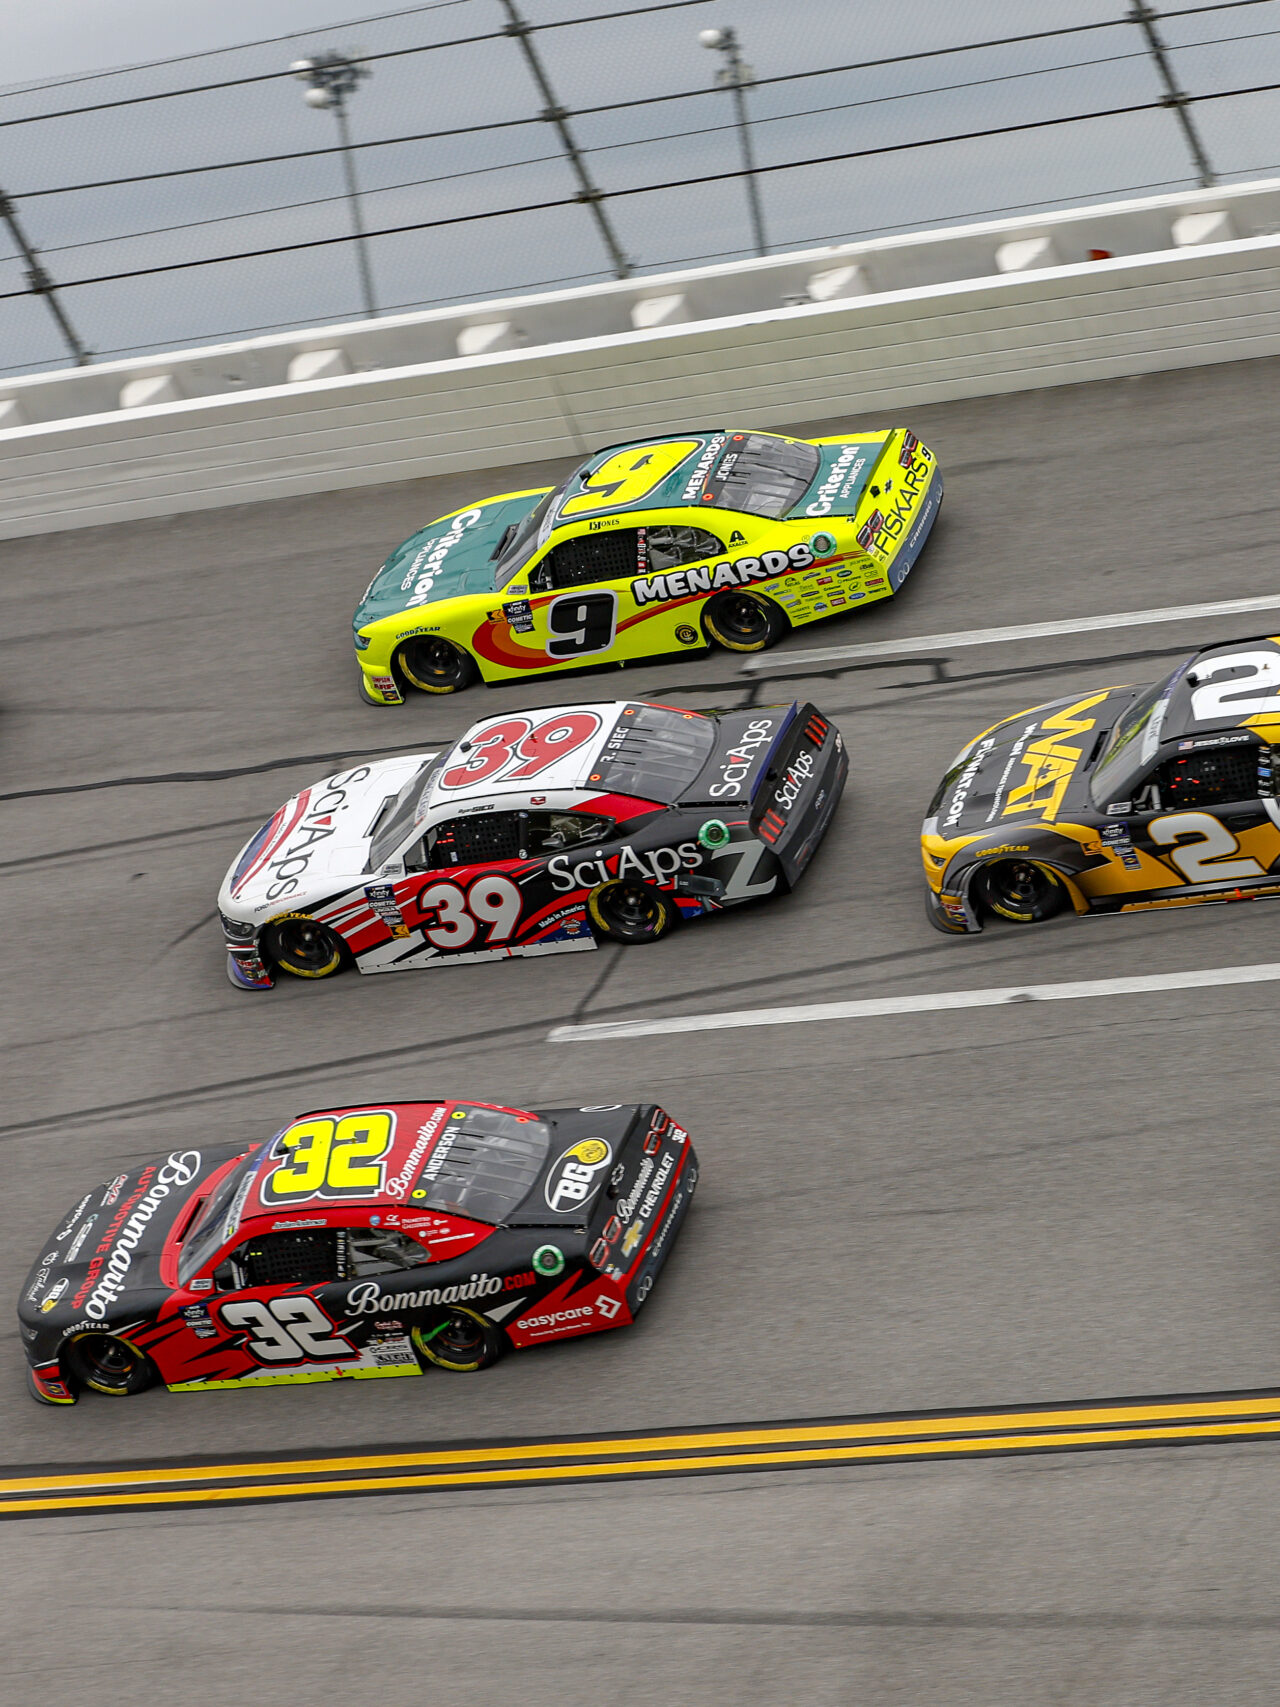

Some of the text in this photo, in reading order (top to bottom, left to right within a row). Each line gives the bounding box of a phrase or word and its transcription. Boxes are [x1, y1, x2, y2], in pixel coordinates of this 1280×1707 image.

[557, 438, 706, 520] 9
[682, 434, 727, 501] MENARDS
[715, 453, 738, 481] JONES
[806, 445, 860, 516] Criterion
[840, 458, 866, 498] APPLIANCES
[873, 457, 929, 556] FISKARS
[405, 508, 482, 607] Criterion
[632, 542, 814, 605] MENARDS
[396, 626, 441, 640] GOODYEAR
[546, 589, 619, 660] 9
[438, 710, 603, 791] 39
[607, 726, 630, 751] SIEG
[709, 719, 773, 797] SciAps
[1000, 690, 1111, 822] WAT
[774, 750, 814, 811] SciAps
[266, 766, 372, 901] SciAps
[1146, 811, 1269, 885] 2
[547, 843, 703, 892] SciAps
[417, 872, 523, 950] 39
[537, 915, 556, 929] Made
[559, 903, 587, 918] America
[259, 1108, 398, 1207] 32
[422, 1126, 461, 1182] ANDERSON
[639, 1152, 675, 1219] CHEVROLET
[84, 1150, 202, 1320] Bommarito
[95, 1166, 157, 1254] AUTOMOTIVE
[71, 1256, 105, 1310] GROUP
[517, 1303, 595, 1330] easycare
[62, 1320, 110, 1338] GOODYEAR
[218, 1295, 357, 1362] 32
